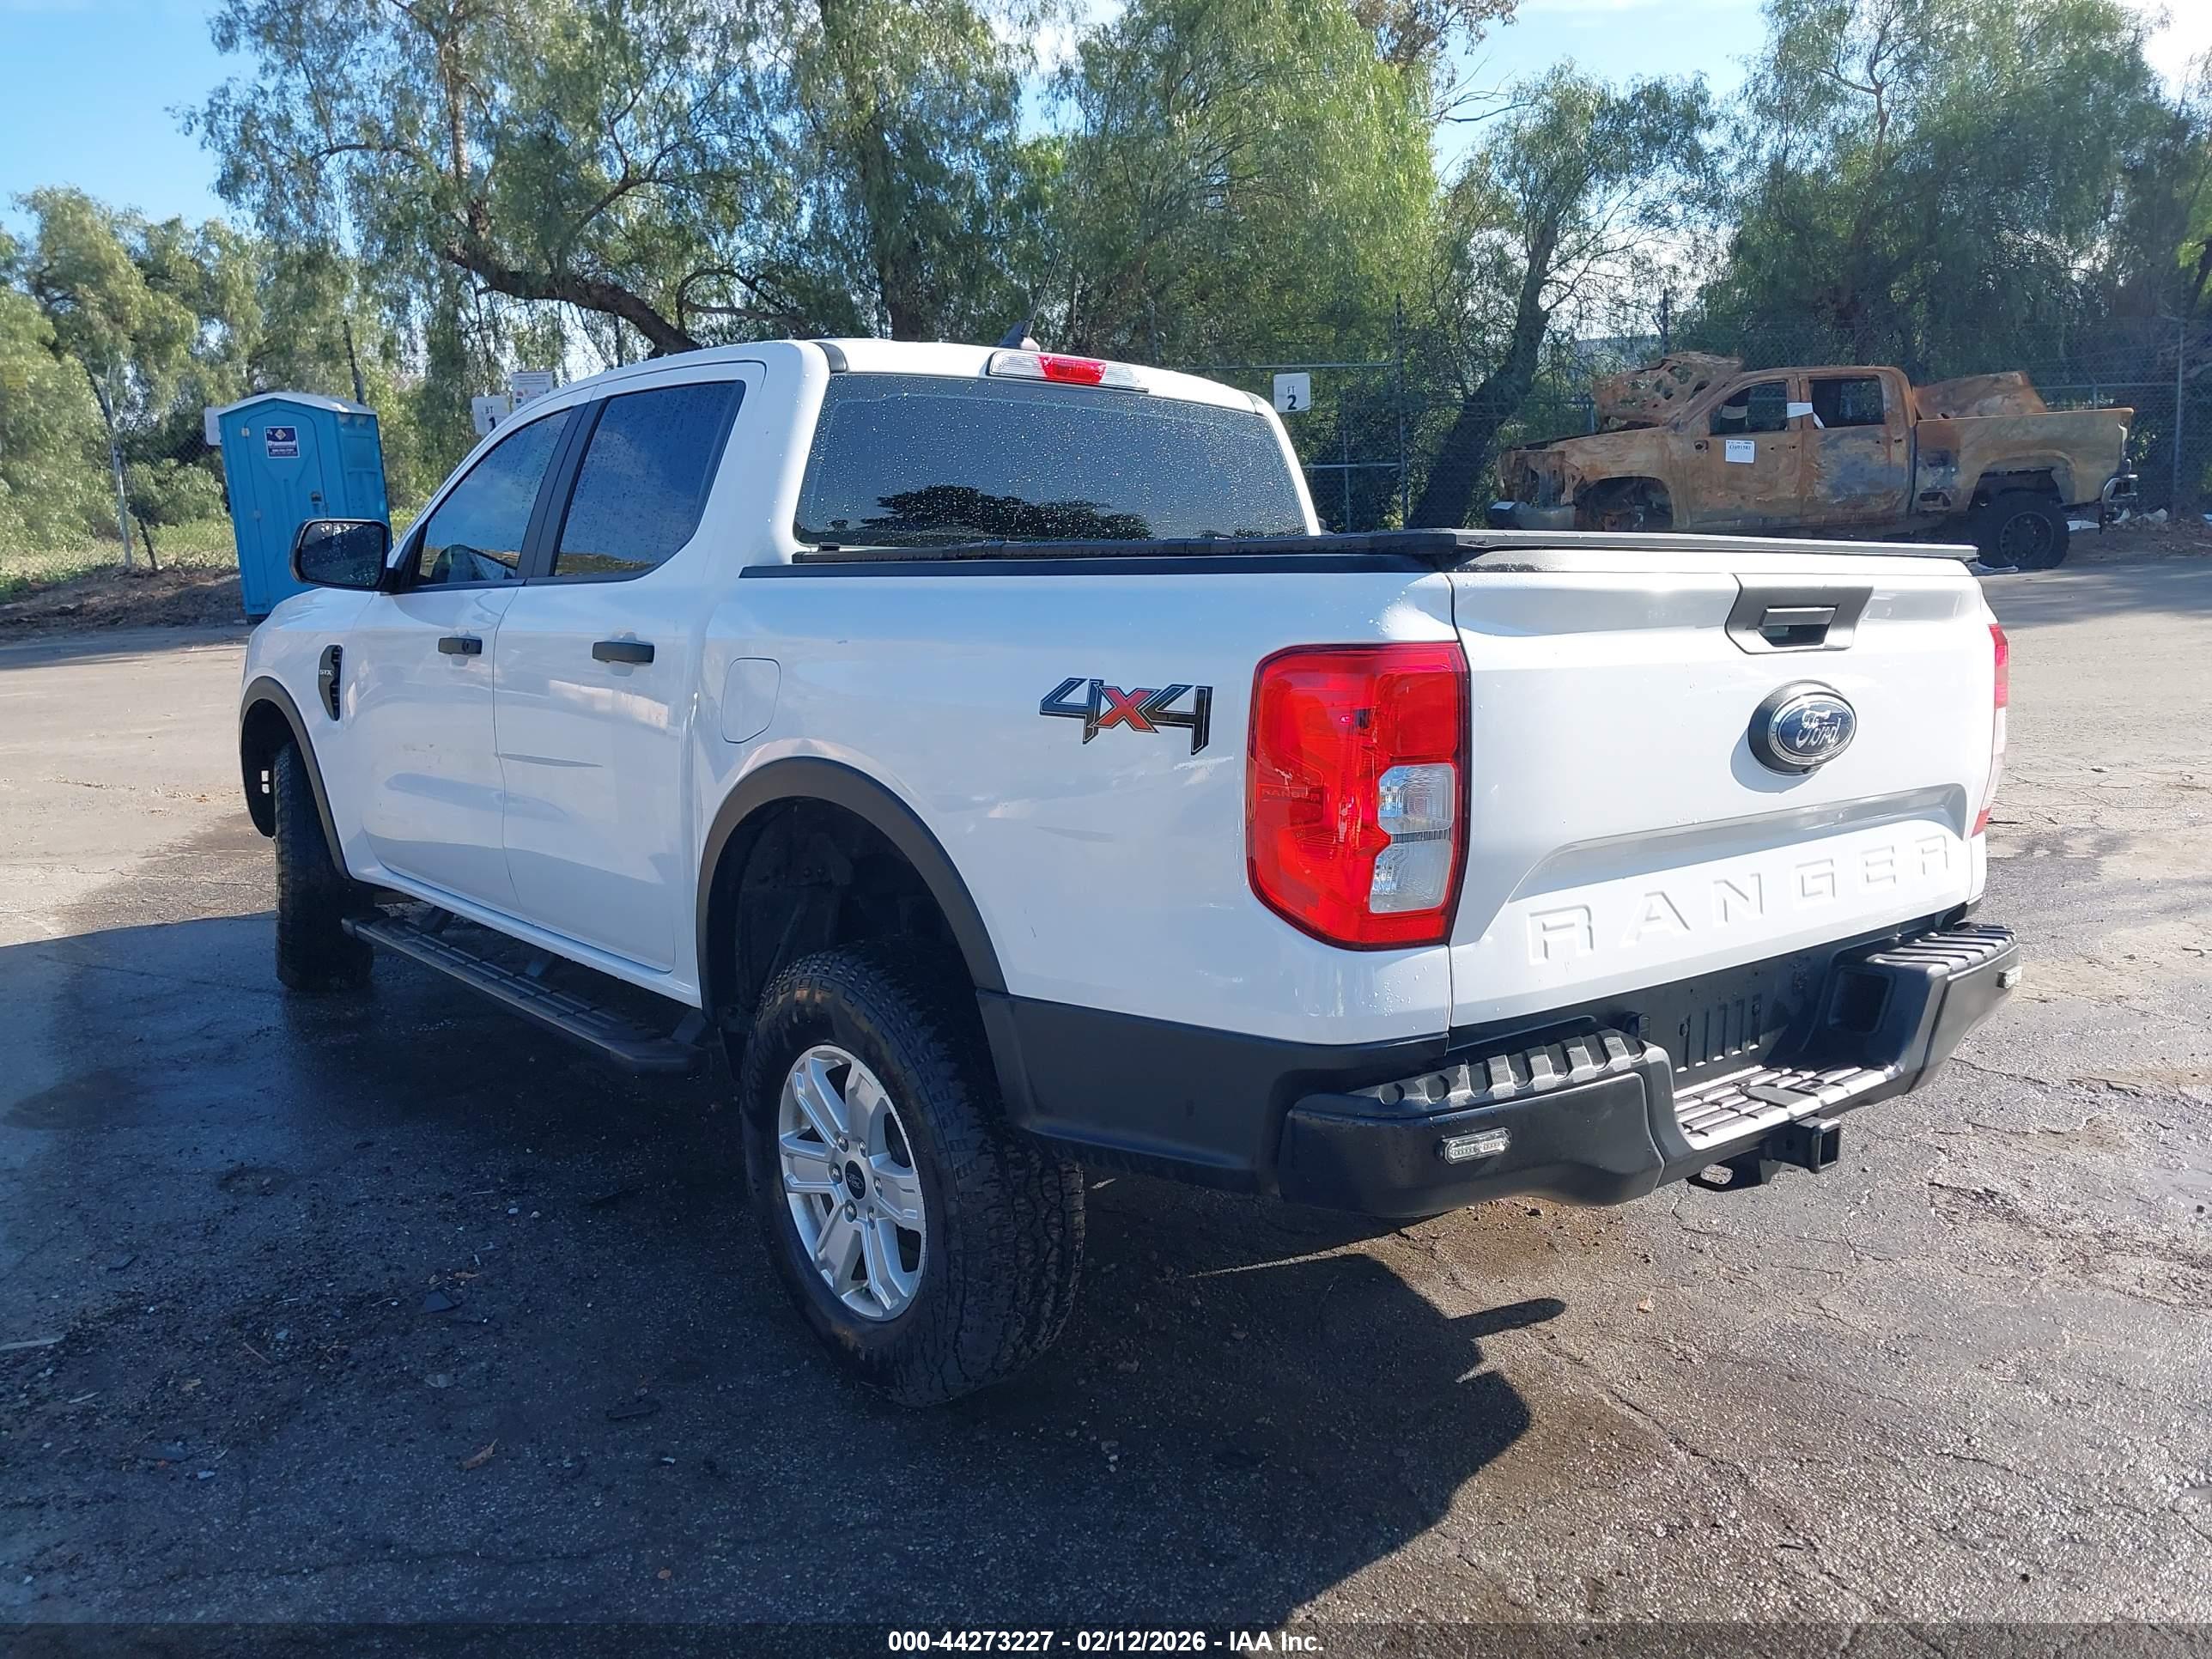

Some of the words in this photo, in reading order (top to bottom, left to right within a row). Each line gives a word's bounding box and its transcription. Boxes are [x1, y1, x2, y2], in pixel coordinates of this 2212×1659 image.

[1287, 386, 1296, 394] FT
[1287, 394, 1297, 410] 2
[1796, 709, 1843, 750] Ford
[1526, 833, 1950, 967] RANGER
